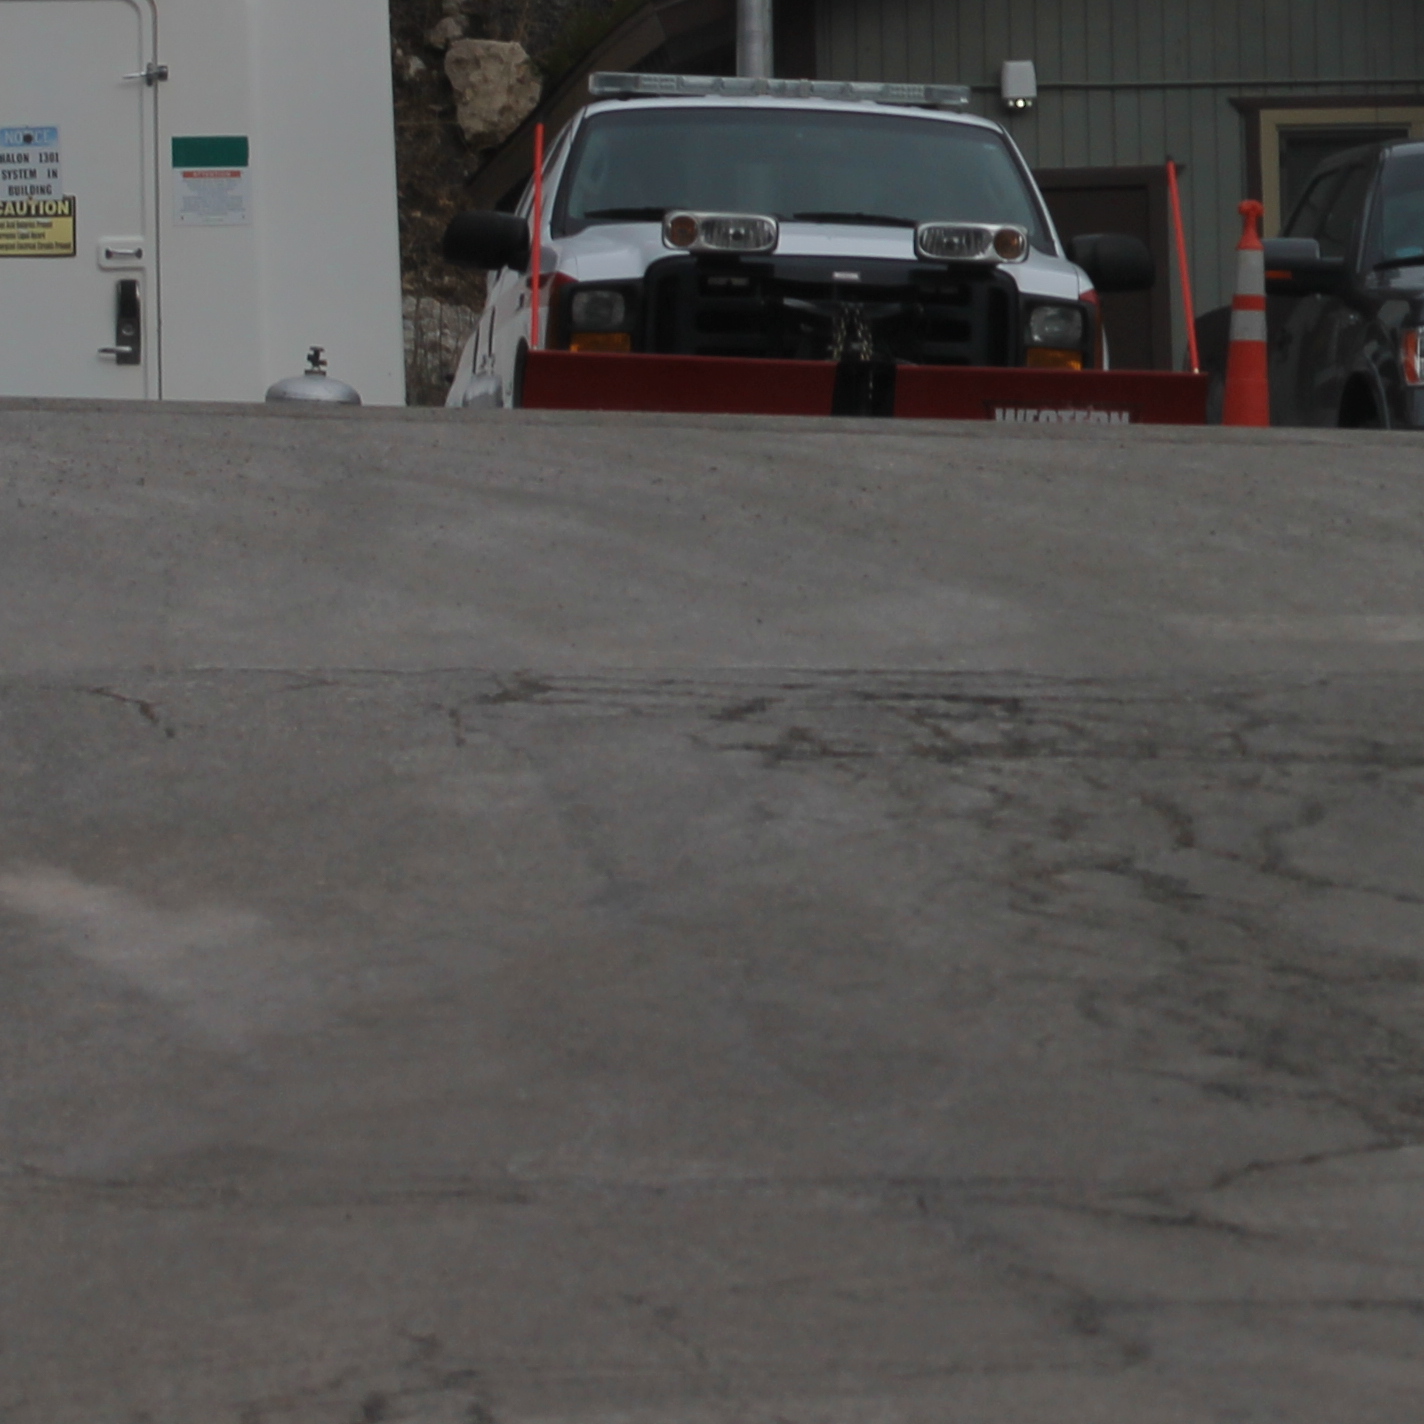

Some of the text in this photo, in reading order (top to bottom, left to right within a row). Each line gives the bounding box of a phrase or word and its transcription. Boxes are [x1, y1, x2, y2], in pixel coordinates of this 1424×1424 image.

[39, 151, 59, 164] 1301
[2, 168, 58, 180] SYSTEM IN
[8, 184, 52, 196] BUILDING
